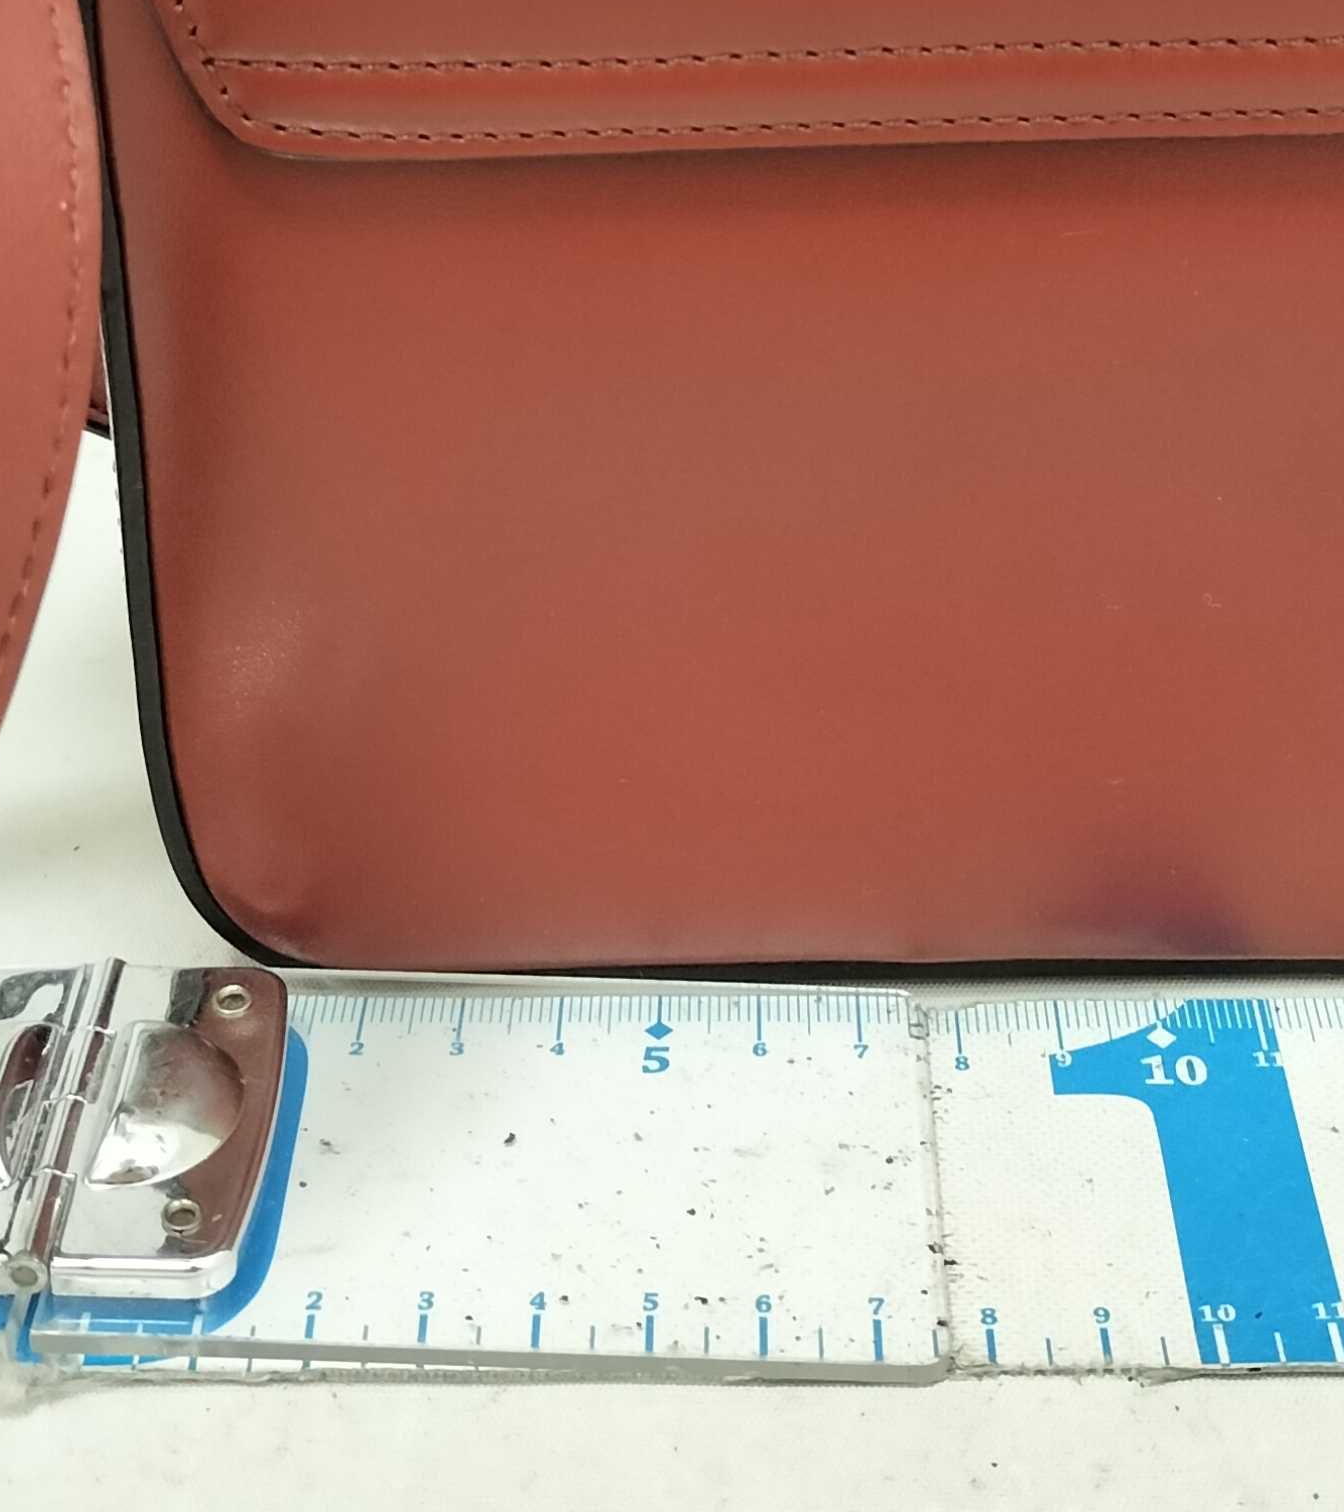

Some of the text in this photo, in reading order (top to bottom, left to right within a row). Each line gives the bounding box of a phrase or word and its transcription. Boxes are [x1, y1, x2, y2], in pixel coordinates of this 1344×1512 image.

[349, 1042, 364, 1055] 2
[449, 1042, 464, 1055] 3
[550, 1042, 565, 1055] 4
[641, 1046, 670, 1073] 5
[752, 1042, 767, 1056] 6
[854, 1044, 869, 1058] 7
[955, 1055, 970, 1071] 8
[1055, 1051, 1072, 1067] 9
[1140, 1055, 1208, 1086] 10
[1253, 1051, 1284, 1067] 11
[306, 1292, 323, 1310] 2
[417, 1292, 434, 1310] 3
[530, 1292, 546, 1310] 4
[642, 1293, 658, 1311] 5
[755, 1295, 771, 1313] 6
[868, 1298, 885, 1315] 7
[980, 1308, 997, 1325] 8
[1093, 1307, 1111, 1324] 9
[1198, 1304, 1236, 1322] 10
